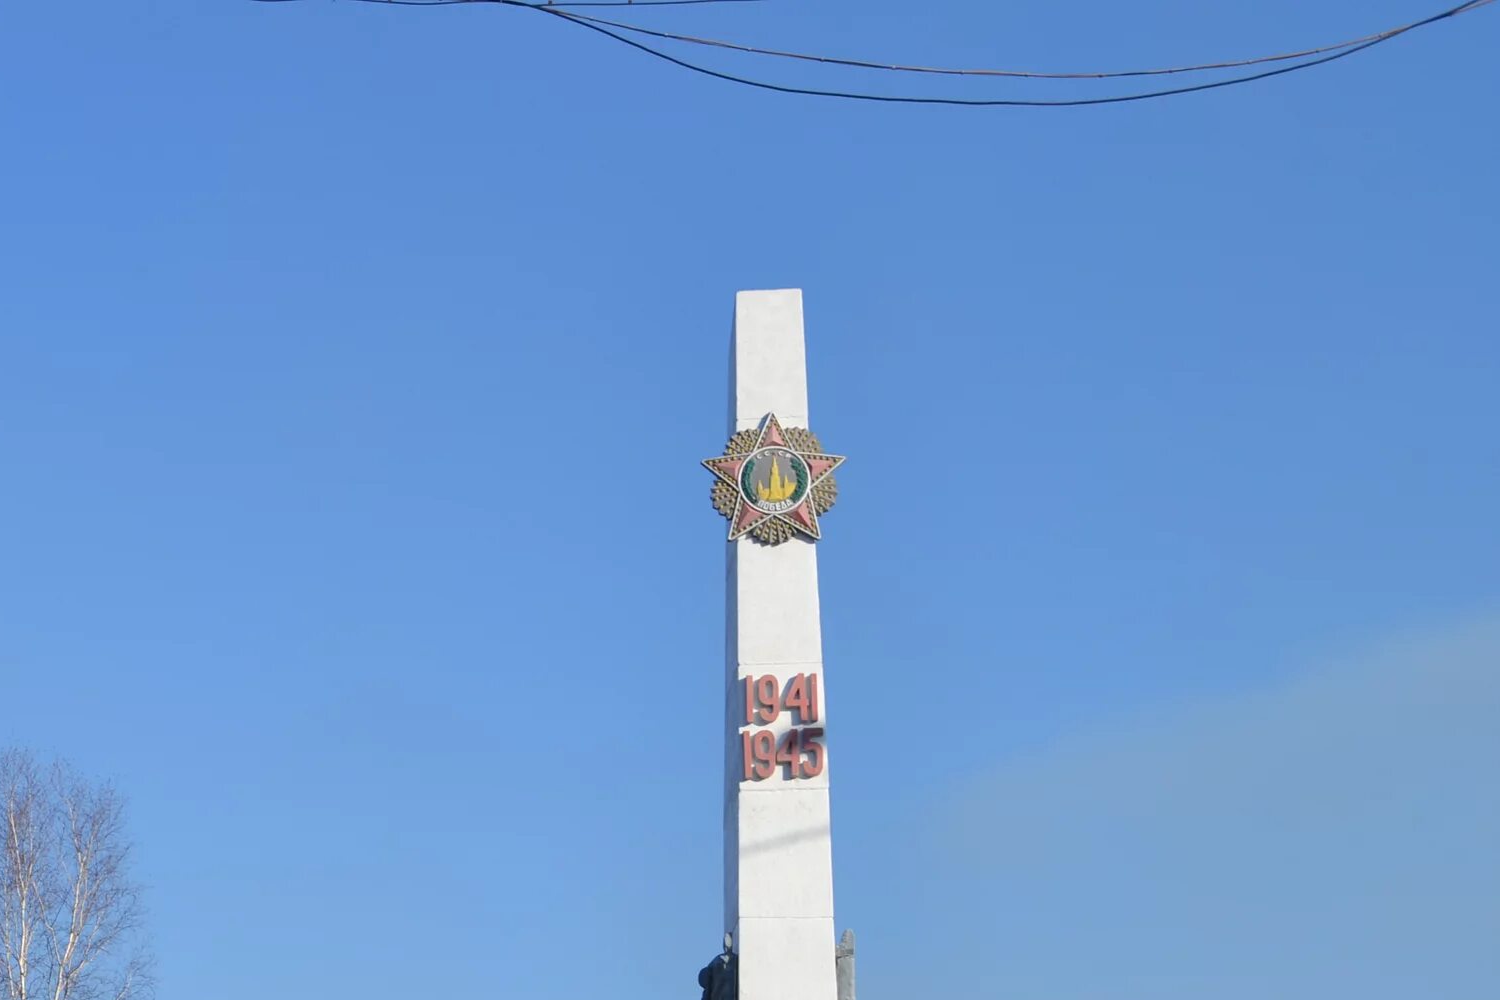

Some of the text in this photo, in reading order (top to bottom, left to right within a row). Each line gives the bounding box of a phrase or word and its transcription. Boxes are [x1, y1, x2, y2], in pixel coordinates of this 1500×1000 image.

[757, 499, 793, 511] ПОБЕДА
[745, 673, 819, 724] 1941
[743, 727, 824, 780] 1945
